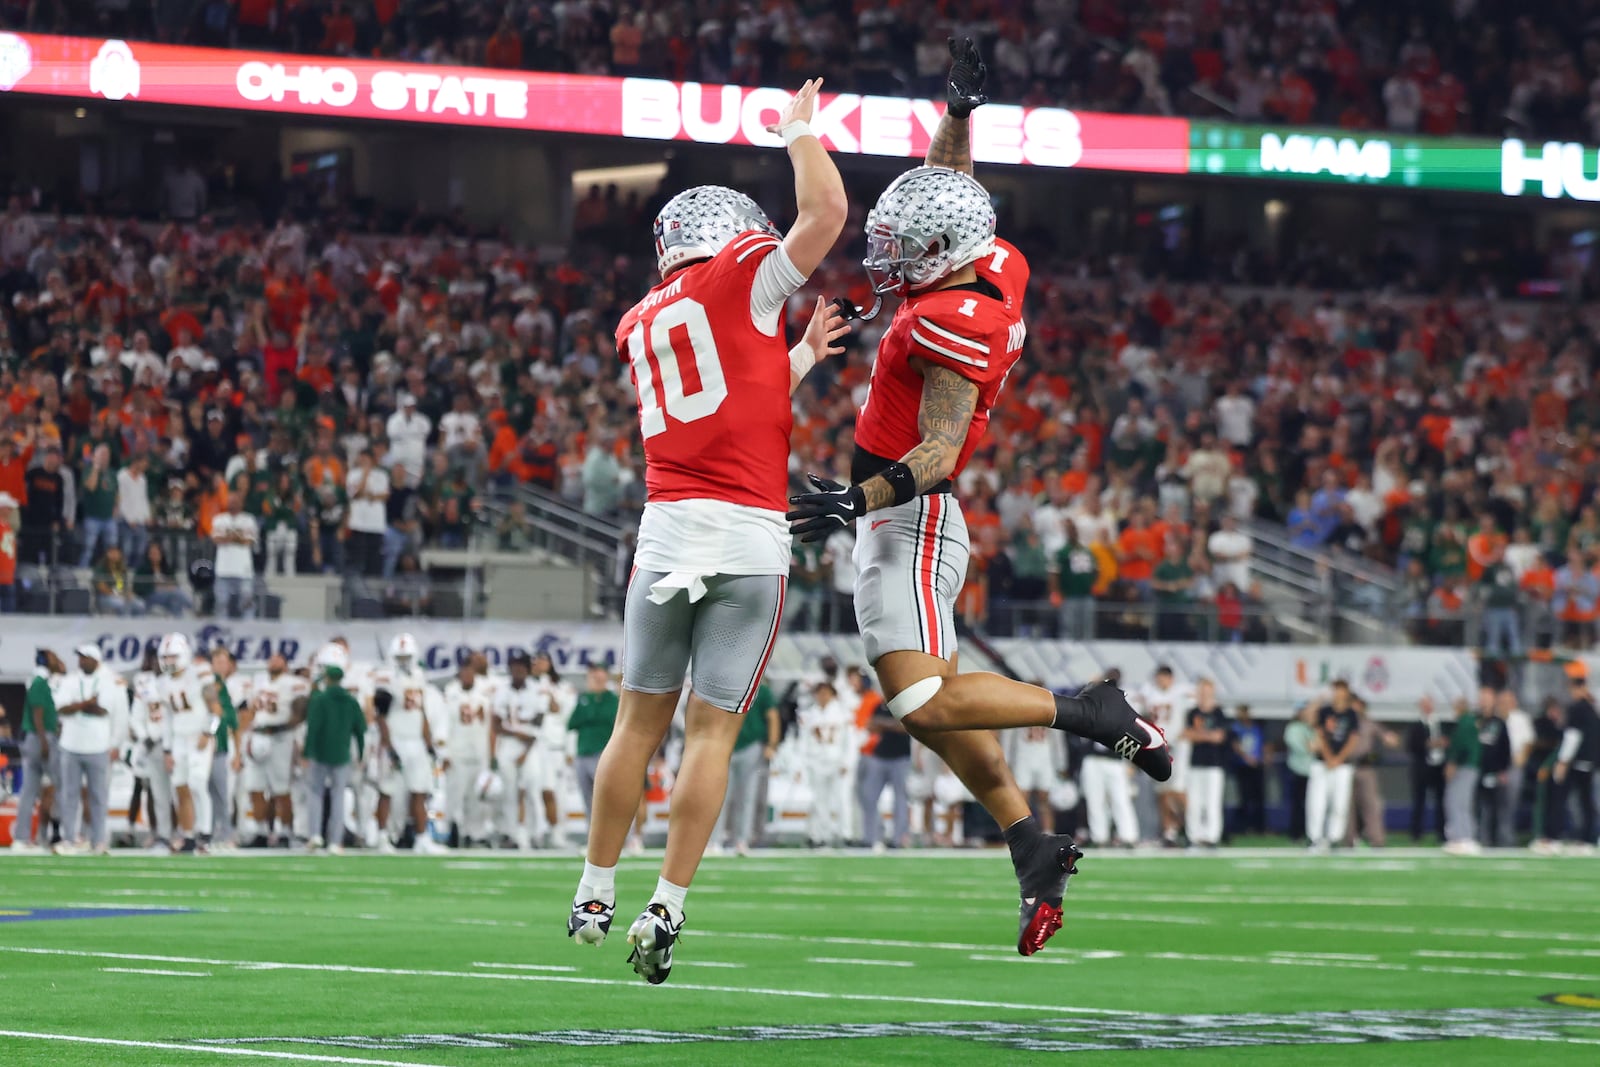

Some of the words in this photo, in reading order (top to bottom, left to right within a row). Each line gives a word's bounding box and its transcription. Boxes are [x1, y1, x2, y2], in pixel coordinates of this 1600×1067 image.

[236, 61, 358, 107] OHIO
[370, 71, 529, 119] STATE
[1260, 132, 1392, 178] MIAMI
[957, 298, 979, 318] 1
[627, 297, 729, 441] 10
